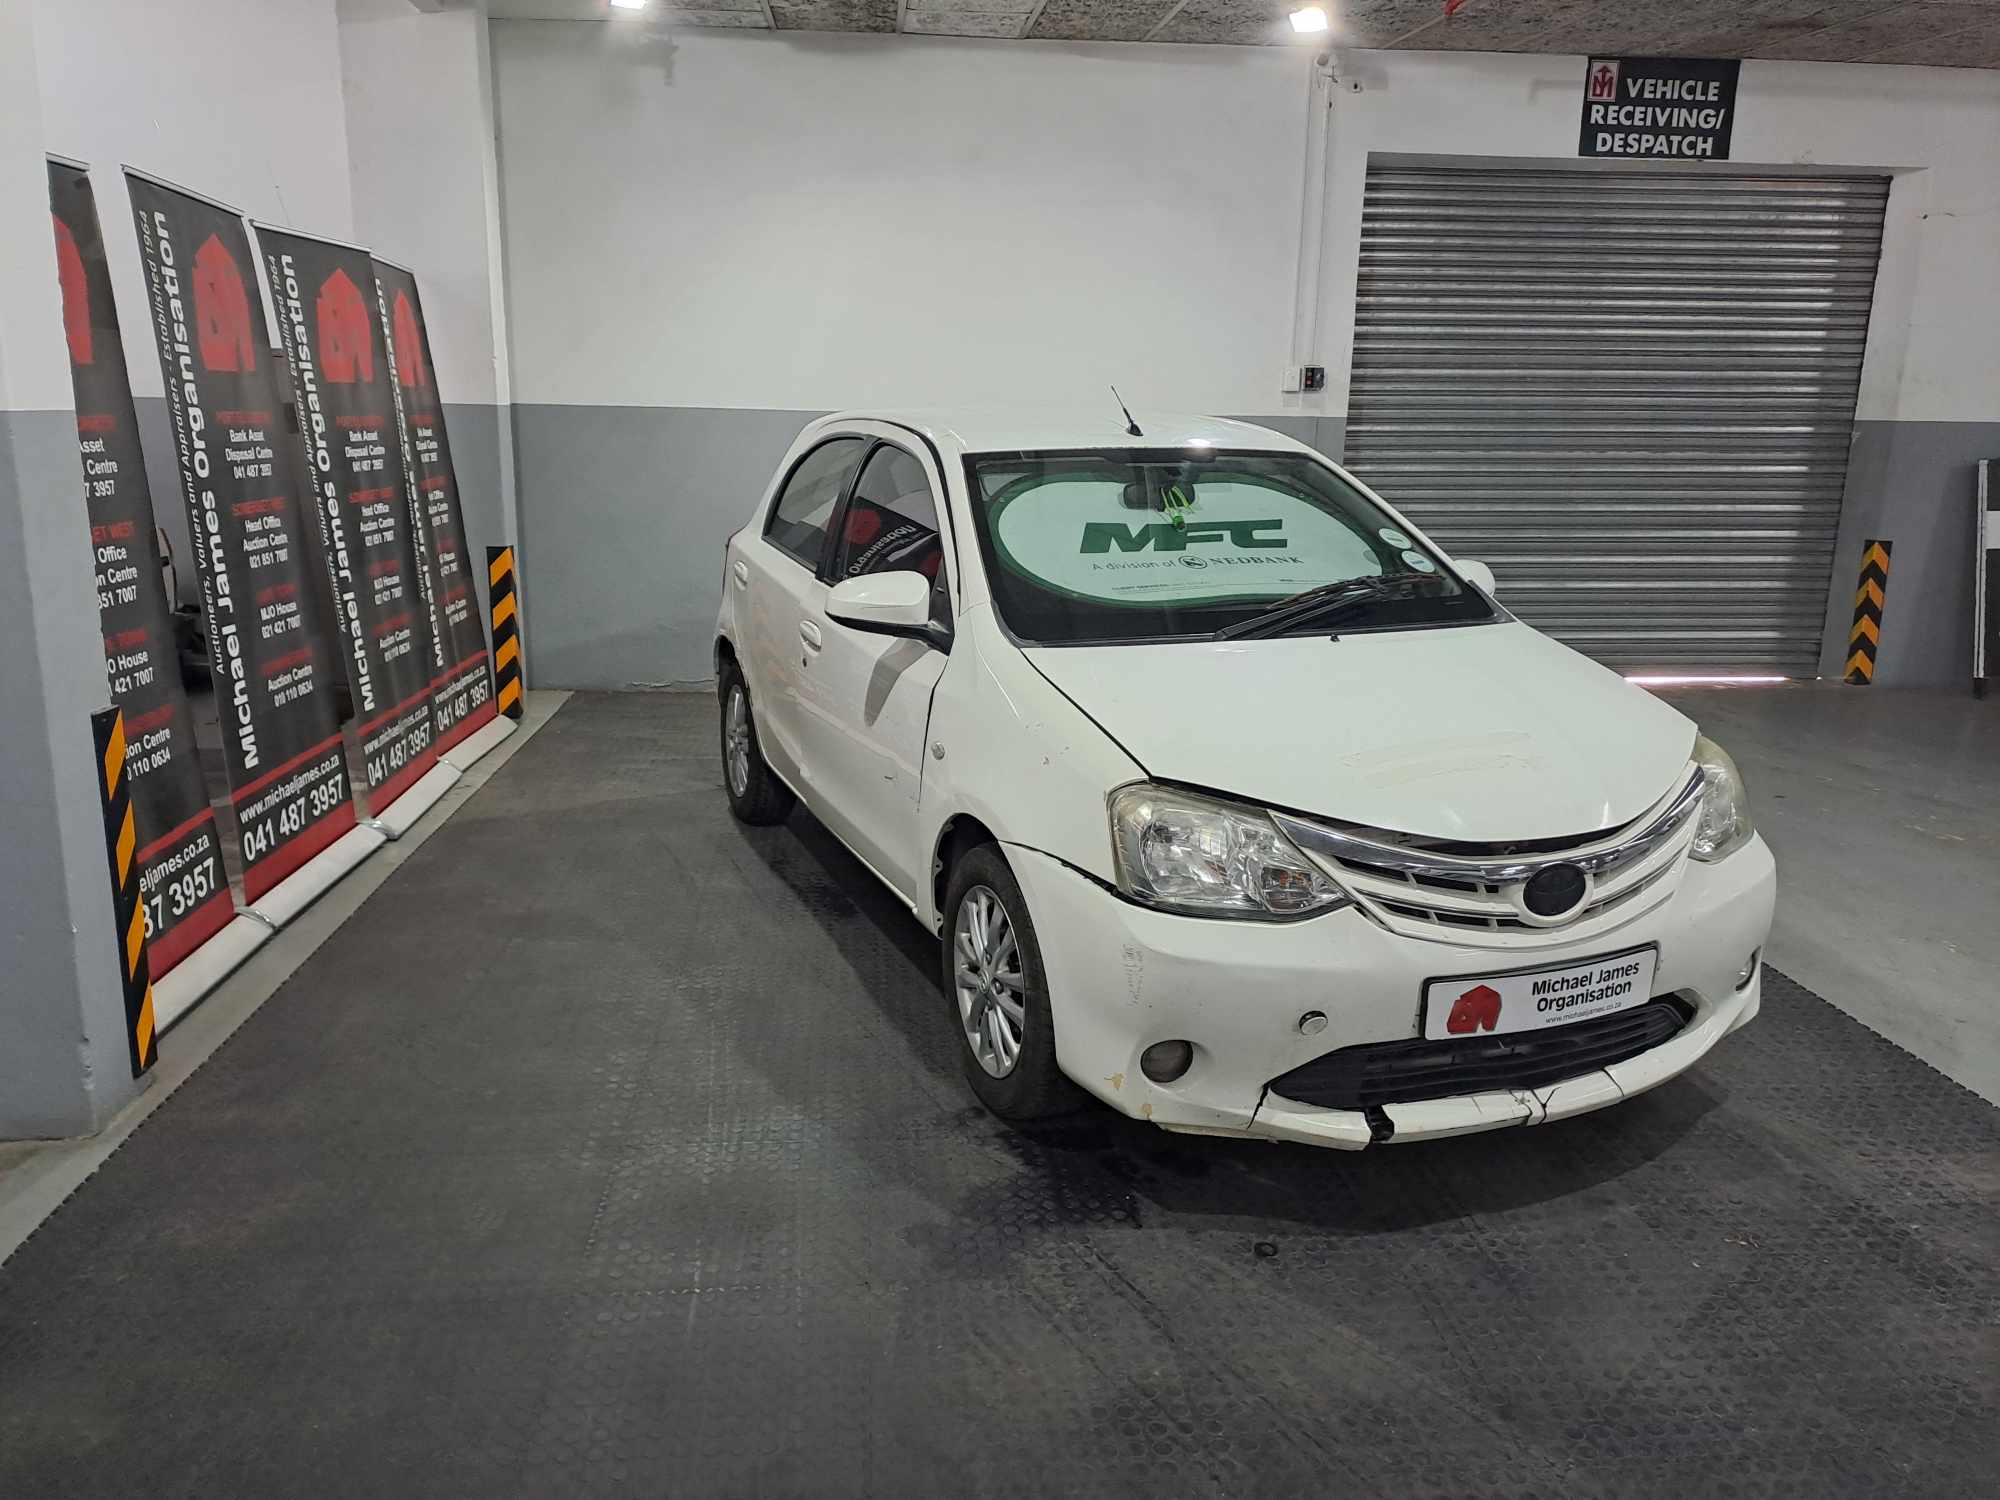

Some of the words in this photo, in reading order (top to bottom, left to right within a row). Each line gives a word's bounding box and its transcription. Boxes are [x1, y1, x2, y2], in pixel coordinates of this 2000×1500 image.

[1626, 78, 1720, 101] VEHICLE
[1590, 104, 1726, 130] RECEIVING/
[1596, 132, 1714, 156] DESPATCH
[139, 210, 153, 254] 1964
[147, 259, 172, 361] Established
[154, 211, 210, 478] Organisation
[281, 254, 330, 472] Organisation
[169, 376, 190, 466] Appraisers
[87, 459, 118, 475] Centre
[233, 465, 245, 480] 041
[246, 464, 259, 477] 487
[93, 480, 115, 497] 3957
[183, 471, 197, 503] and
[243, 536, 269, 552] Auction
[324, 481, 352, 583] James
[1080, 518, 1288, 554] MFC
[98, 546, 127, 563] Office
[202, 490, 234, 613] James
[262, 552, 274, 566] 851
[1092, 563, 1102, 571] A
[1106, 558, 1160, 571] division
[1162, 559, 1176, 568] of
[1208, 554, 1304, 567] NEDBANK
[107, 566, 137, 584] Centre
[116, 585, 137, 604] 7007
[274, 620, 286, 635] 421
[118, 650, 148, 672] House
[343, 591, 375, 712] Michael
[114, 675, 132, 694] 421
[134, 667, 153, 687] 7007
[222, 623, 259, 769] Michael
[437, 703, 454, 732] 041
[454, 692, 468, 719] 487
[470, 679, 488, 708] 3957
[143, 728, 171, 750] Centre
[367, 753, 388, 787] 041
[389, 739, 408, 770] 487
[408, 721, 430, 756] 3957
[132, 758, 149, 777] 110
[152, 746, 171, 769] 0634
[240, 754, 340, 824] www.michaeljames.co.za
[243, 818, 275, 861] 041
[279, 796, 306, 836] 487
[309, 773, 343, 816] 3957
[140, 834, 210, 893] eljames.co.za
[143, 894, 163, 938] 87
[169, 857, 215, 916] 3957
[1532, 971, 1593, 996] Michael
[1596, 961, 1640, 985] James
[1536, 981, 1632, 1012] Organisation
